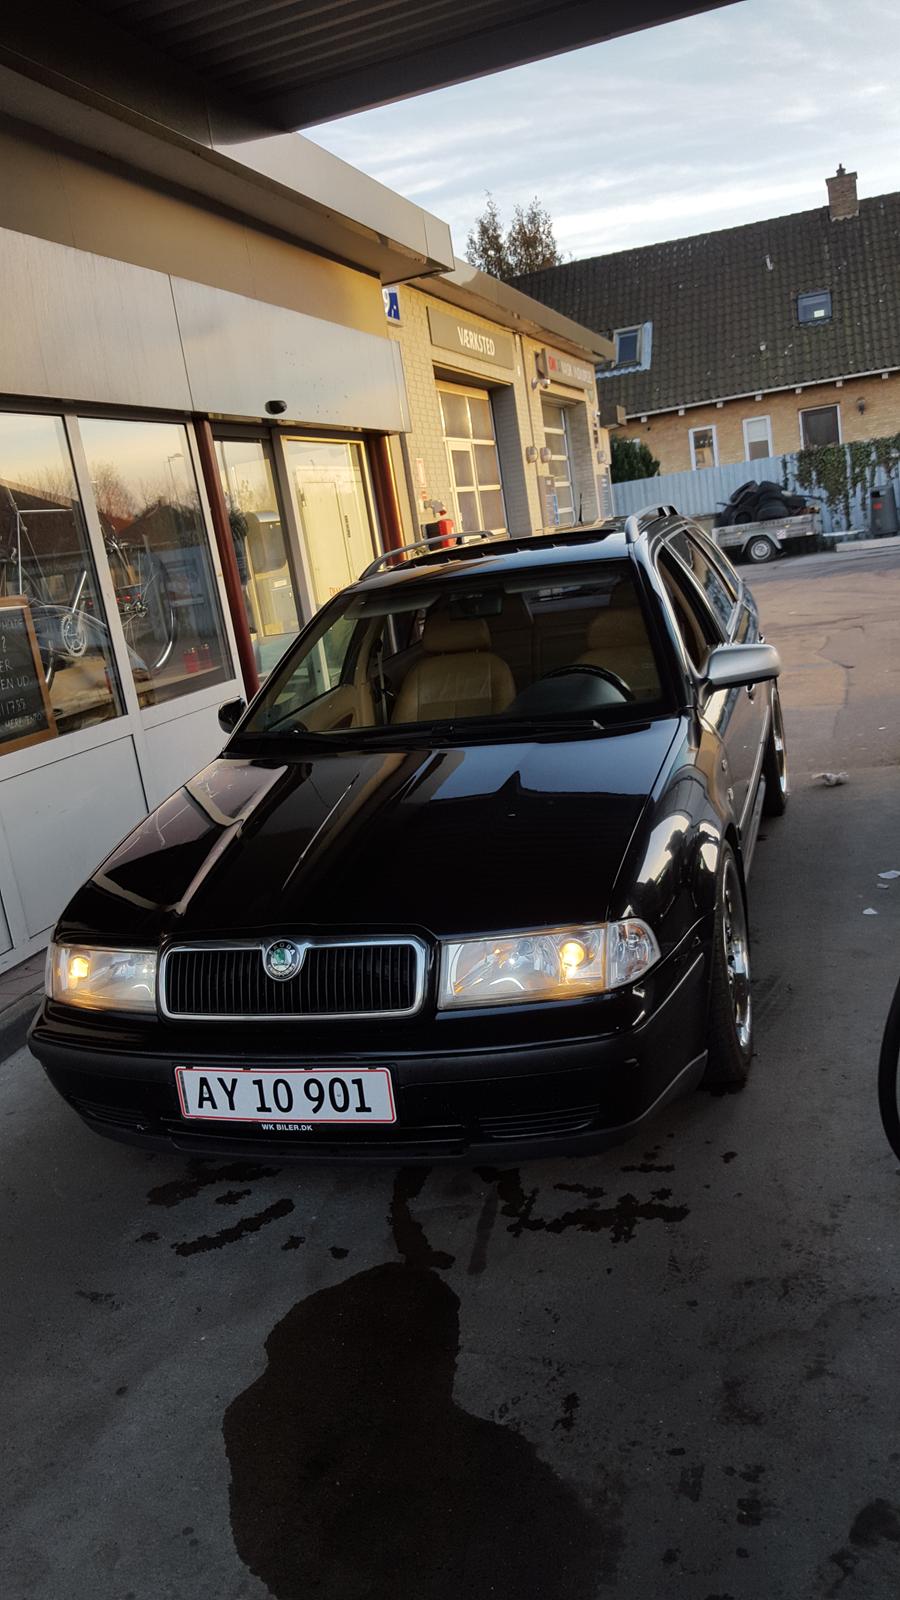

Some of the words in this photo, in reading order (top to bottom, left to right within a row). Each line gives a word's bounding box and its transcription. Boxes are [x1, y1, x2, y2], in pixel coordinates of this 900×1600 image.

[457, 326, 495, 356] VÆRKSTED
[197, 1076, 238, 1111] AY
[252, 1078, 294, 1113] 10
[303, 1077, 372, 1114] 901
[261, 1123, 275, 1131] WK
[276, 1123, 313, 1132] BILER.DK
